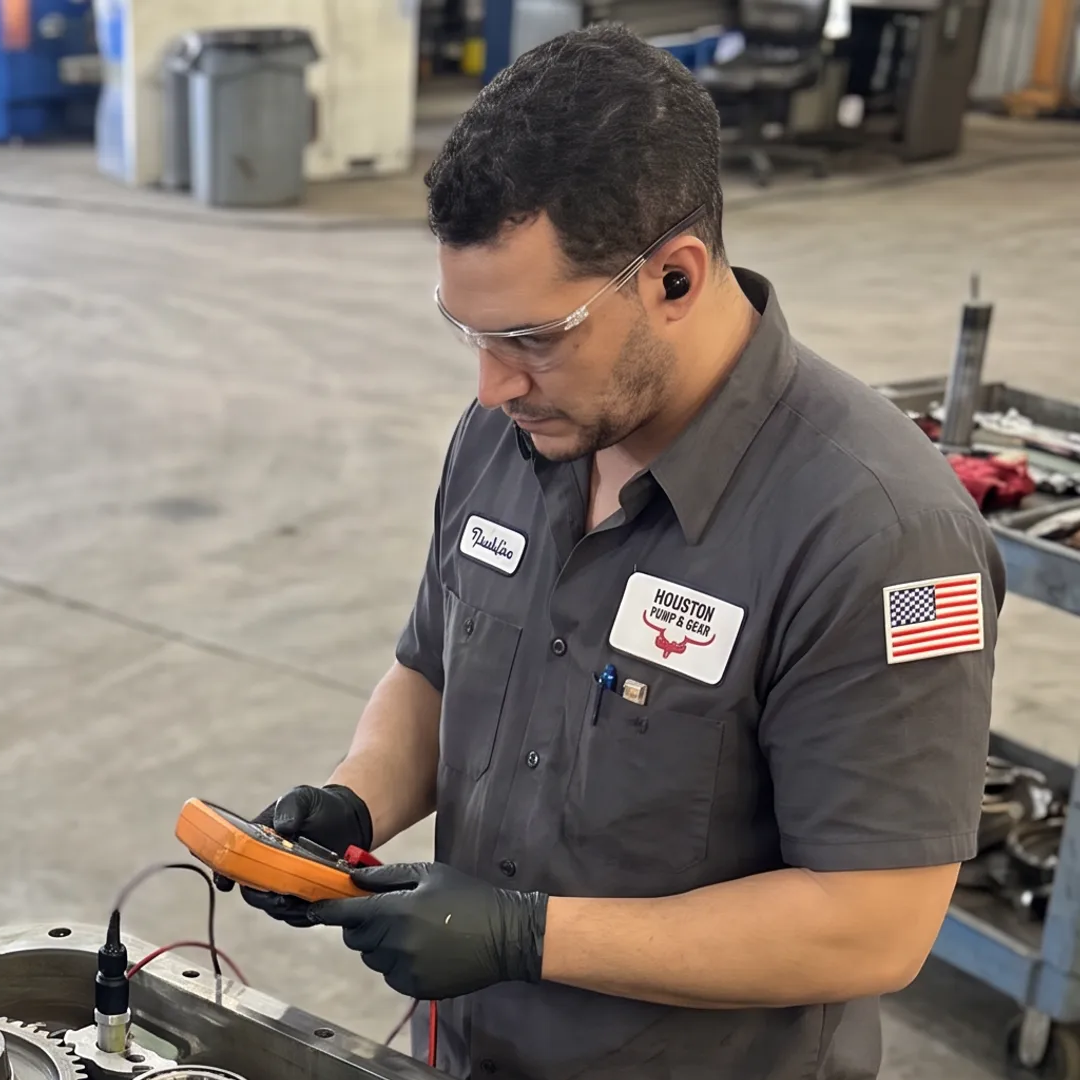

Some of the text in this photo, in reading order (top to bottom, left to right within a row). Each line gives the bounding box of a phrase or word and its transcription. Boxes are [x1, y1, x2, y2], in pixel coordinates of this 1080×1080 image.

[653, 588, 715, 622] HOUSTON
[650, 606, 711, 637] PUMP & GEAR
